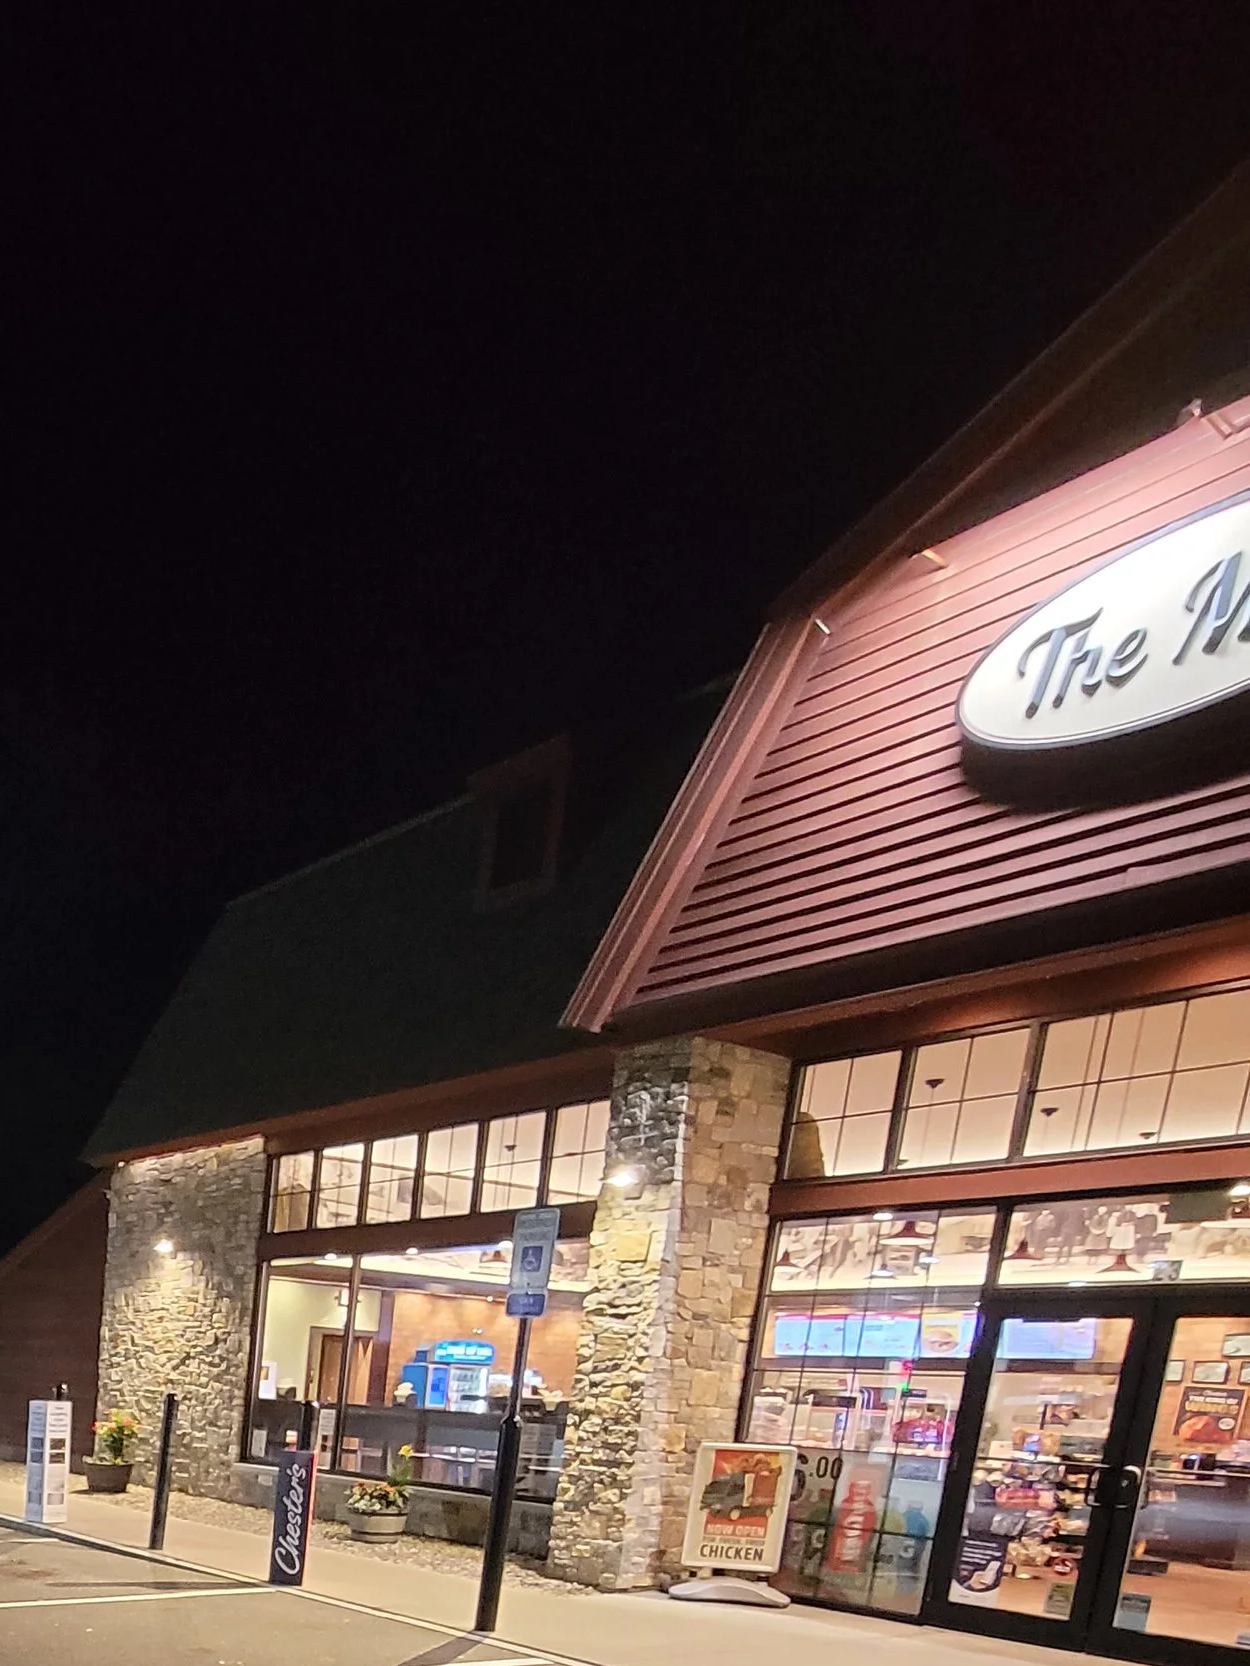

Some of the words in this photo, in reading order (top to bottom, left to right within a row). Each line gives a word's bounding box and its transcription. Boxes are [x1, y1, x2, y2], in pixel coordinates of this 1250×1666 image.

[1016, 606, 1149, 720] The
[274, 1463, 306, 1575] Chester's
[706, 1523, 733, 1535] NOW
[735, 1525, 765, 1537] OPEN
[699, 1543, 764, 1561] CHICKEN
